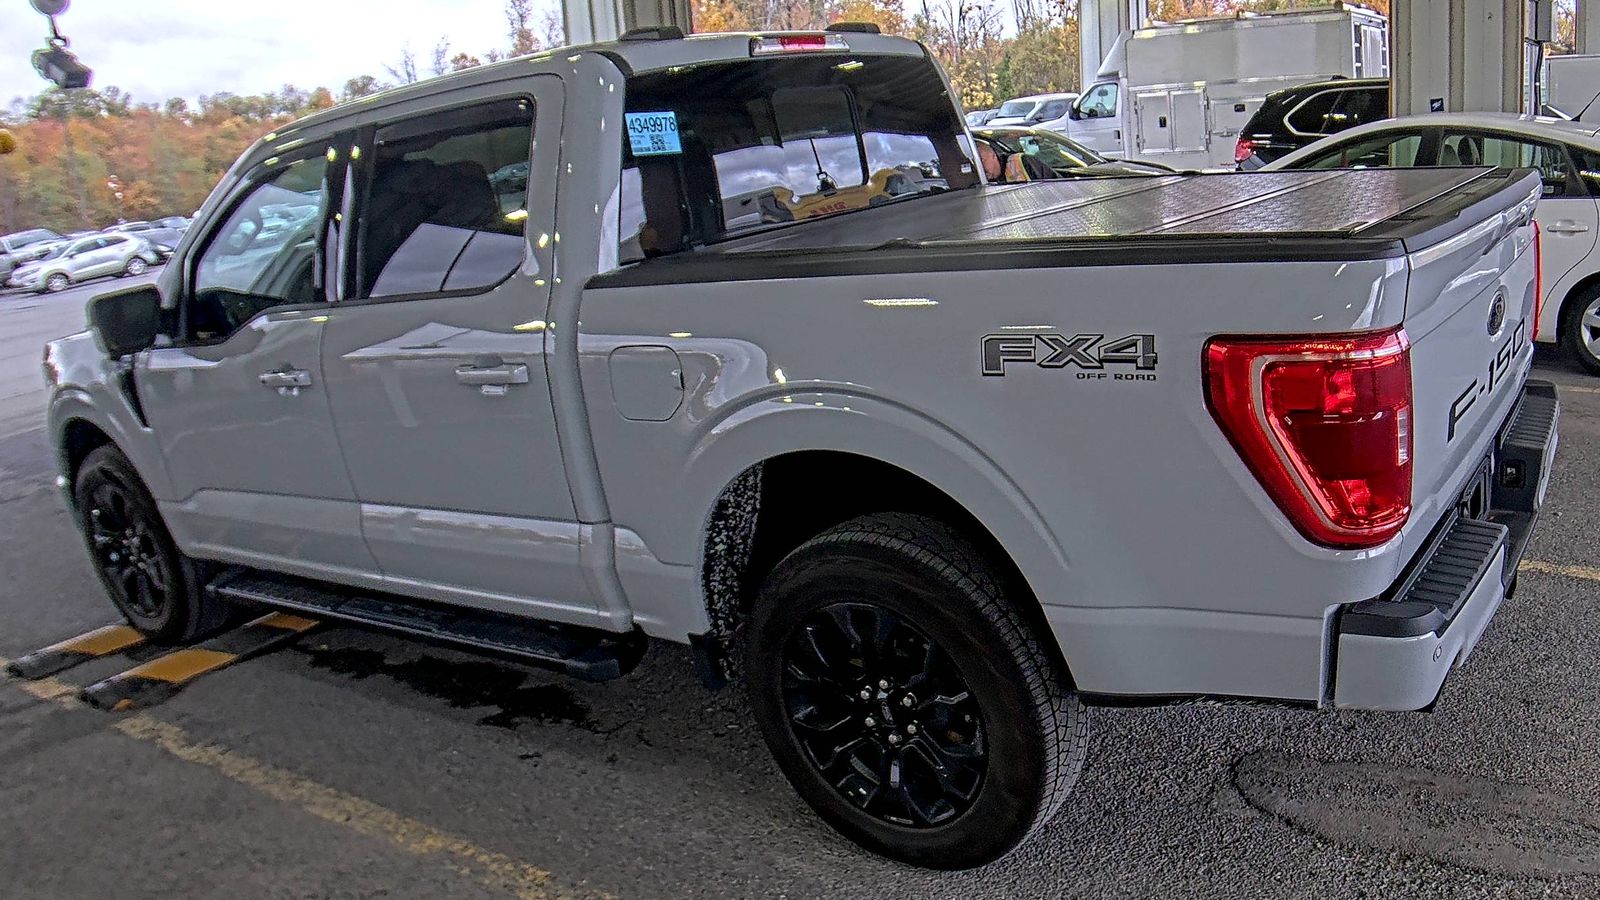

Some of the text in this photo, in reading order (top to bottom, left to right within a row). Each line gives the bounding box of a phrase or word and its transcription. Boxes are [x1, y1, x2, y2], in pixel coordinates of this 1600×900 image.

[629, 117, 677, 133] 4349978
[981, 334, 1158, 376] FX4
[1113, 373, 1157, 381] ROAD
[1447, 317, 1526, 443] F-150
